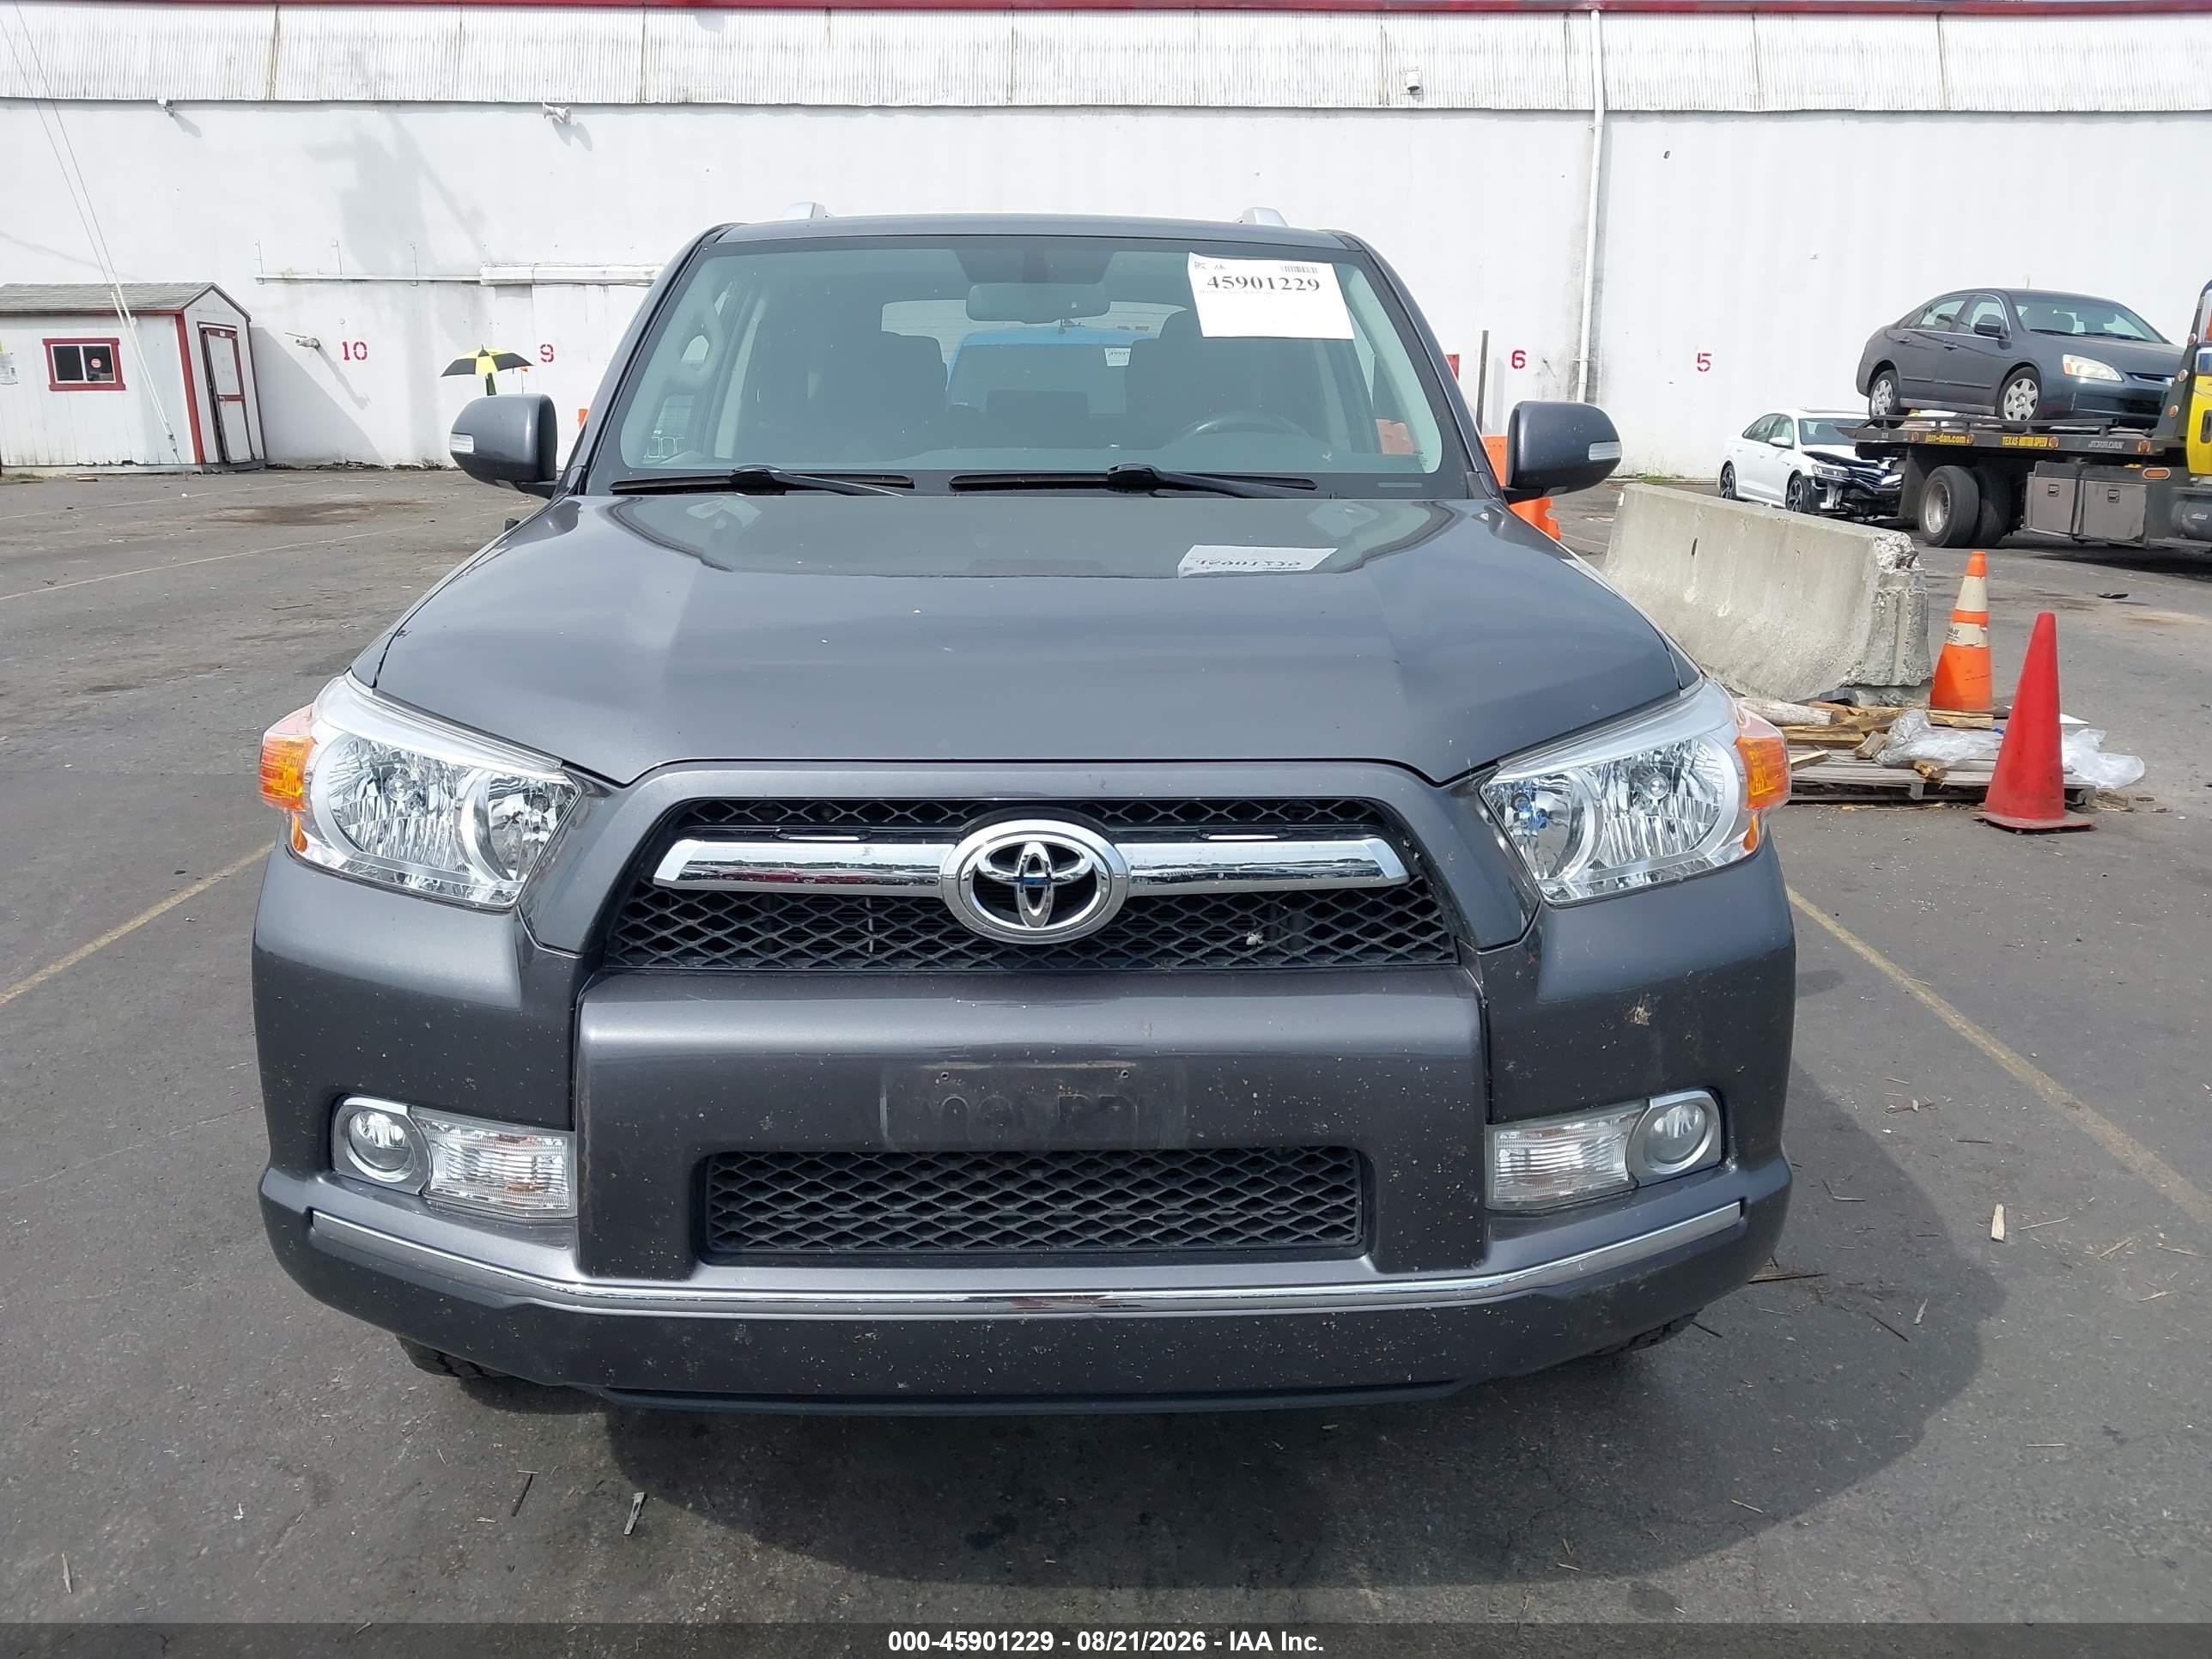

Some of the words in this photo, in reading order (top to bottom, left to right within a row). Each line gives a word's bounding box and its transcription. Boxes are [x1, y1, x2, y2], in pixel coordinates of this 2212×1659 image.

[1207, 276, 1320, 291] 45901229
[343, 341, 368, 362] 10
[540, 343, 555, 362] 9
[1511, 349, 1527, 369] 6
[1696, 353, 1711, 372] 5
[2002, 436, 2019, 447] TEXAS
